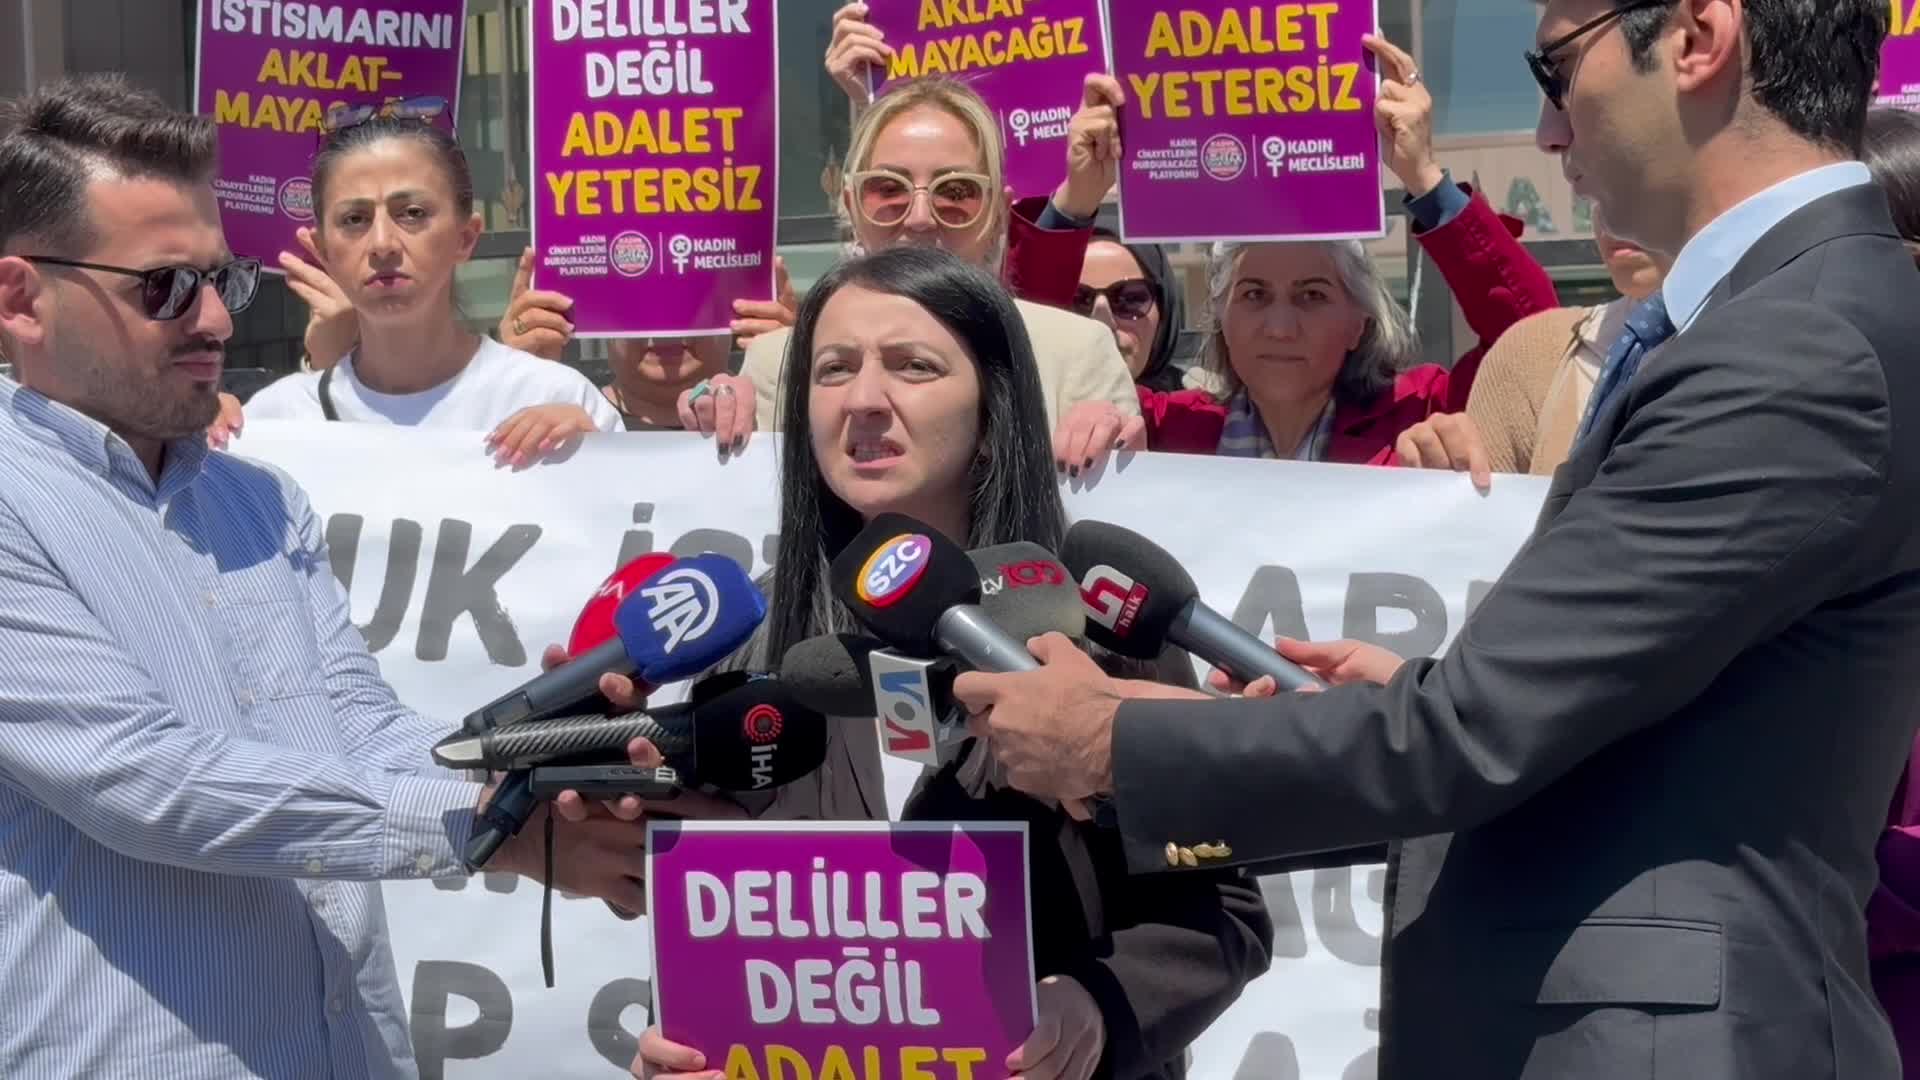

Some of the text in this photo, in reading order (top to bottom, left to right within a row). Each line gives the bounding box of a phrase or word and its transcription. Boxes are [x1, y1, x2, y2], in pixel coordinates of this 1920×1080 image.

[887, 16, 1089, 80] MAYACAĞIZ
[1145, 3, 1339, 58] ADALET
[257, 48, 402, 91] AKLAT-
[585, 40, 713, 98] DEĞİL
[1128, 55, 1362, 119] YETERSİZ
[561, 107, 743, 156] ADALET
[1031, 105, 1071, 123] KADIN
[1033, 120, 1069, 139] MECLİ
[1287, 139, 1333, 155] KADIN
[1288, 152, 1364, 172] MECLİSLERİ
[545, 157, 762, 216] YETERSİZ
[693, 238, 736, 252] KADIN
[694, 249, 761, 269] MECLİSLERİ
[868, 540, 921, 593] SZC
[1119, 595, 1142, 628] halk
[685, 856, 992, 939] DELİLLER
[744, 946, 941, 1025] DEĞİL
